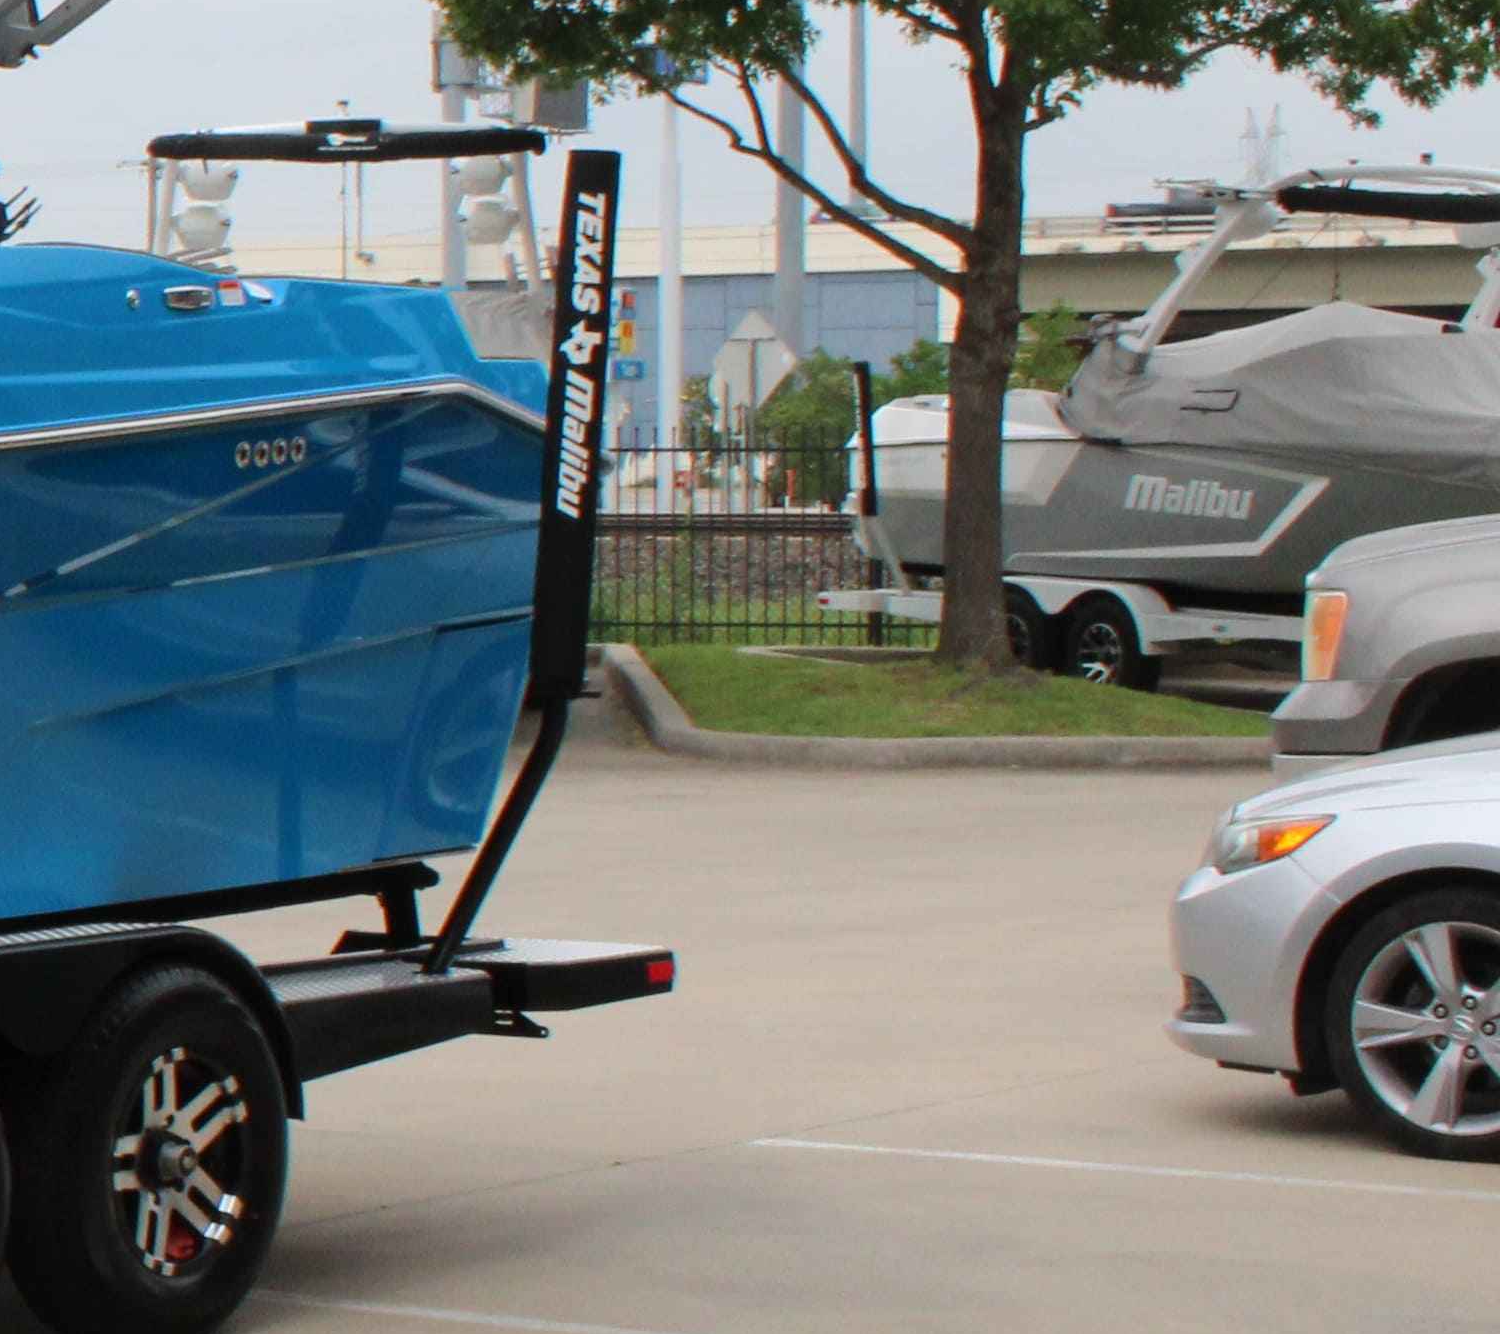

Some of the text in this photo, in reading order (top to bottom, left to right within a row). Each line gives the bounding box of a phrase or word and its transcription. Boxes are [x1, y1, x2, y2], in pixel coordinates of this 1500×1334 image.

[556, 192, 606, 519] TEXAS Malibu
[1123, 473, 1255, 521] Malibu
